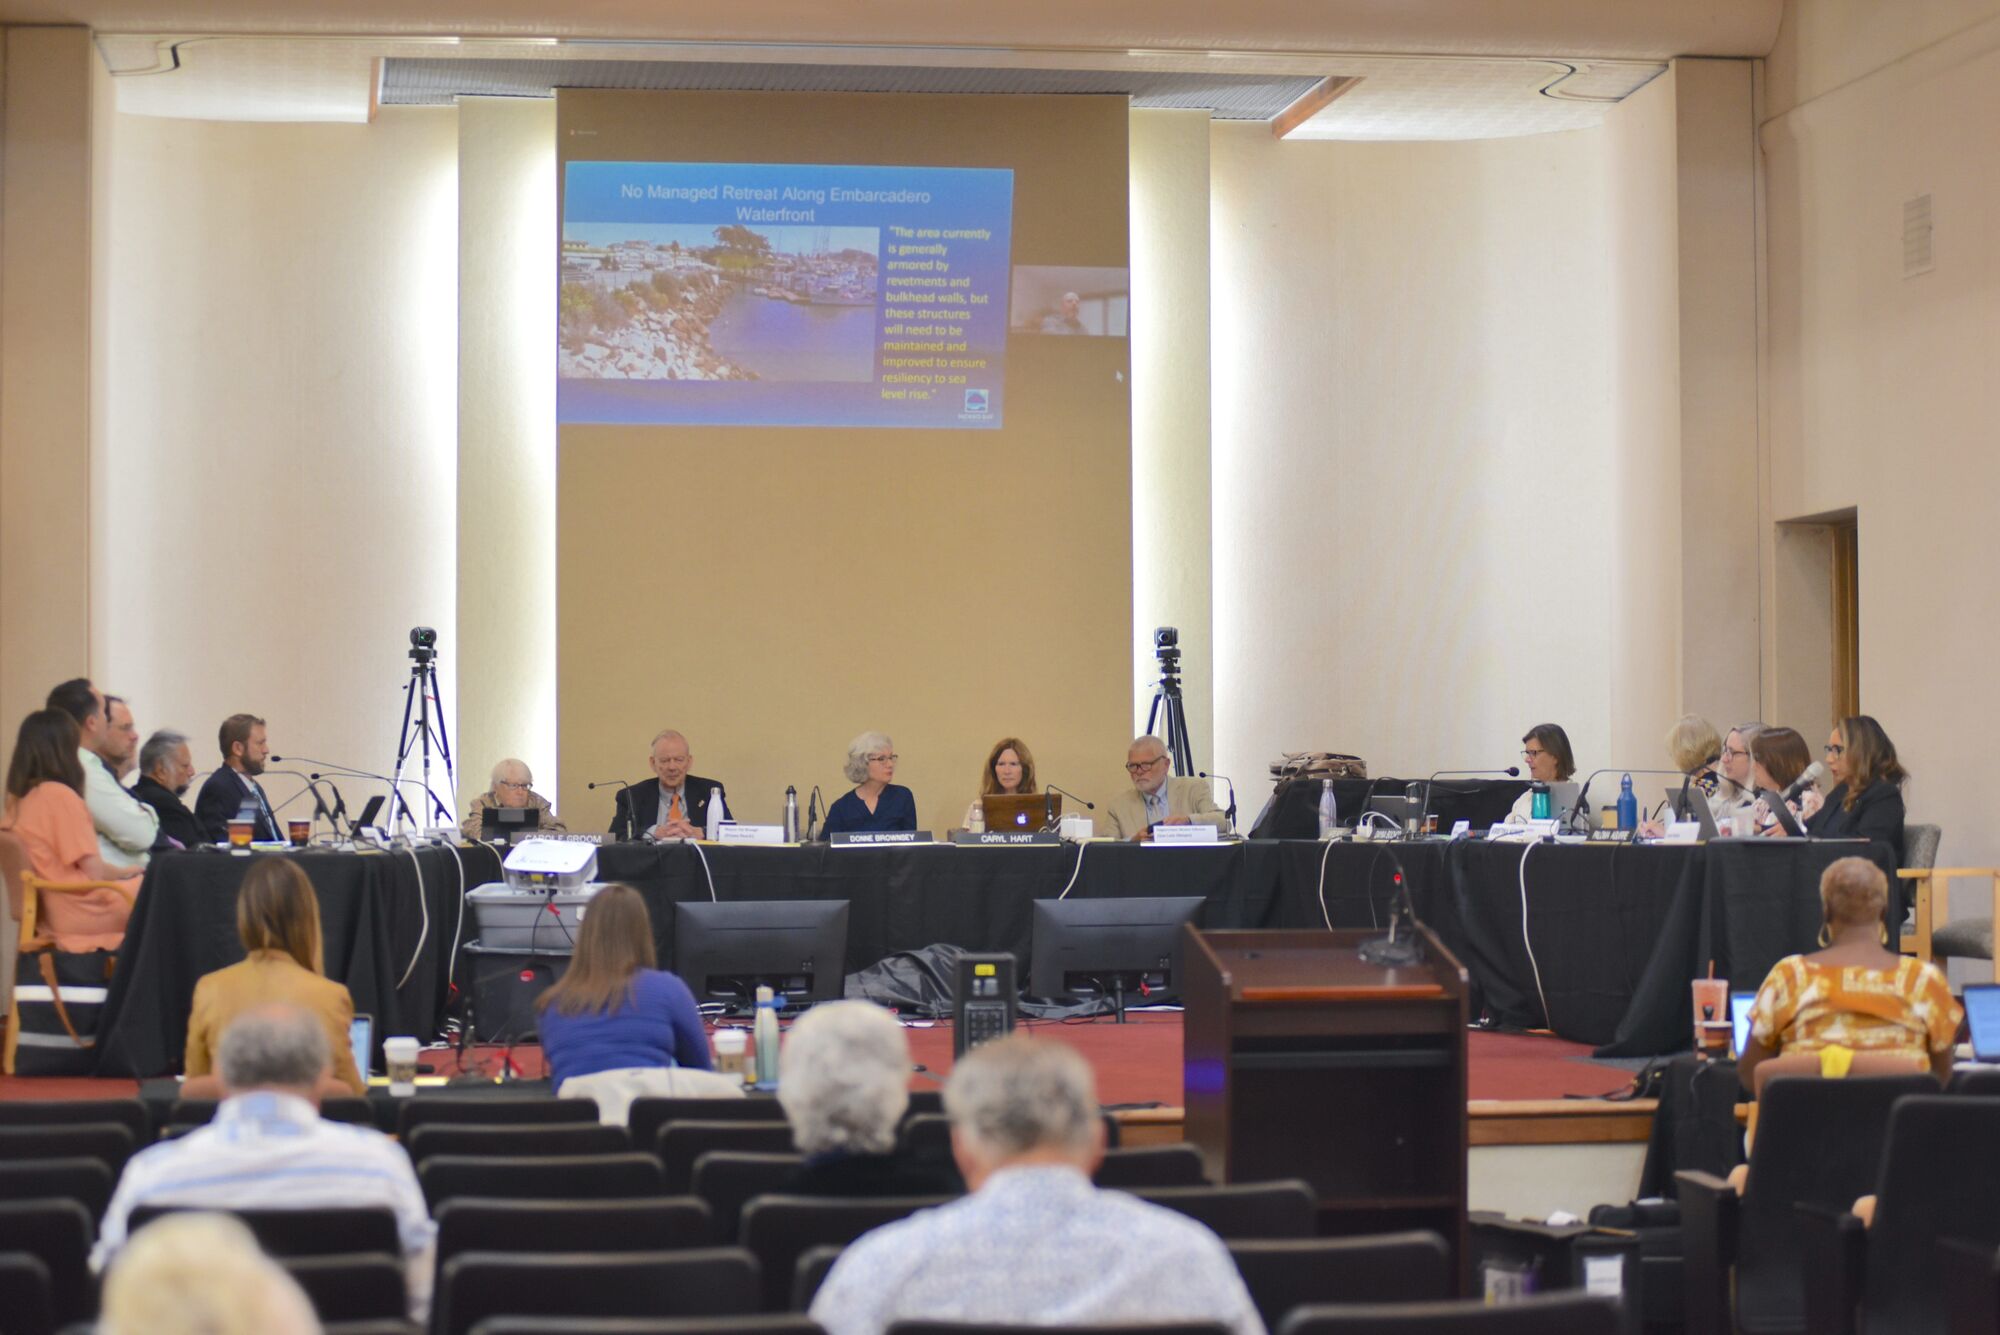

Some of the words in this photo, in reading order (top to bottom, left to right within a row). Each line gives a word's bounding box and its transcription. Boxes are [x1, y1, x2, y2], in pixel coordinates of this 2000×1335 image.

[621, 184, 643, 199] No
[648, 184, 718, 203] Managed
[722, 185, 778, 200] Retreat
[782, 186, 826, 204] Along
[830, 187, 931, 203] Embarcadero
[736, 206, 815, 222] Waterfront
[917, 228, 940, 238] area
[943, 227, 991, 241] currently
[888, 243, 897, 254] is
[899, 243, 948, 256] generally
[887, 260, 934, 271] armored
[936, 260, 949, 272] by
[887, 277, 947, 287] revetments
[950, 277, 970, 287] and
[885, 292, 936, 303] bulkhead
[970, 293, 989, 304] but
[885, 308, 914, 319] these
[917, 309, 971, 320] structures
[884, 324, 903, 335] will
[905, 325, 933, 336] need
[935, 325, 946, 336] to
[949, 325, 963, 336] be
[883, 341, 945, 352] maintained
[946, 342, 967, 352] and
[882, 357, 935, 368] improved
[936, 358, 948, 368] to
[950, 359, 987, 369] ensure
[882, 373, 933, 385] resiliency
[935, 374, 946, 384] to
[948, 375, 967, 385] sea
[881, 388, 906, 400] level
[566, 834, 602, 843] GROOM
[980, 834, 1007, 843] CARYL
[1009, 834, 1033, 843] HART
